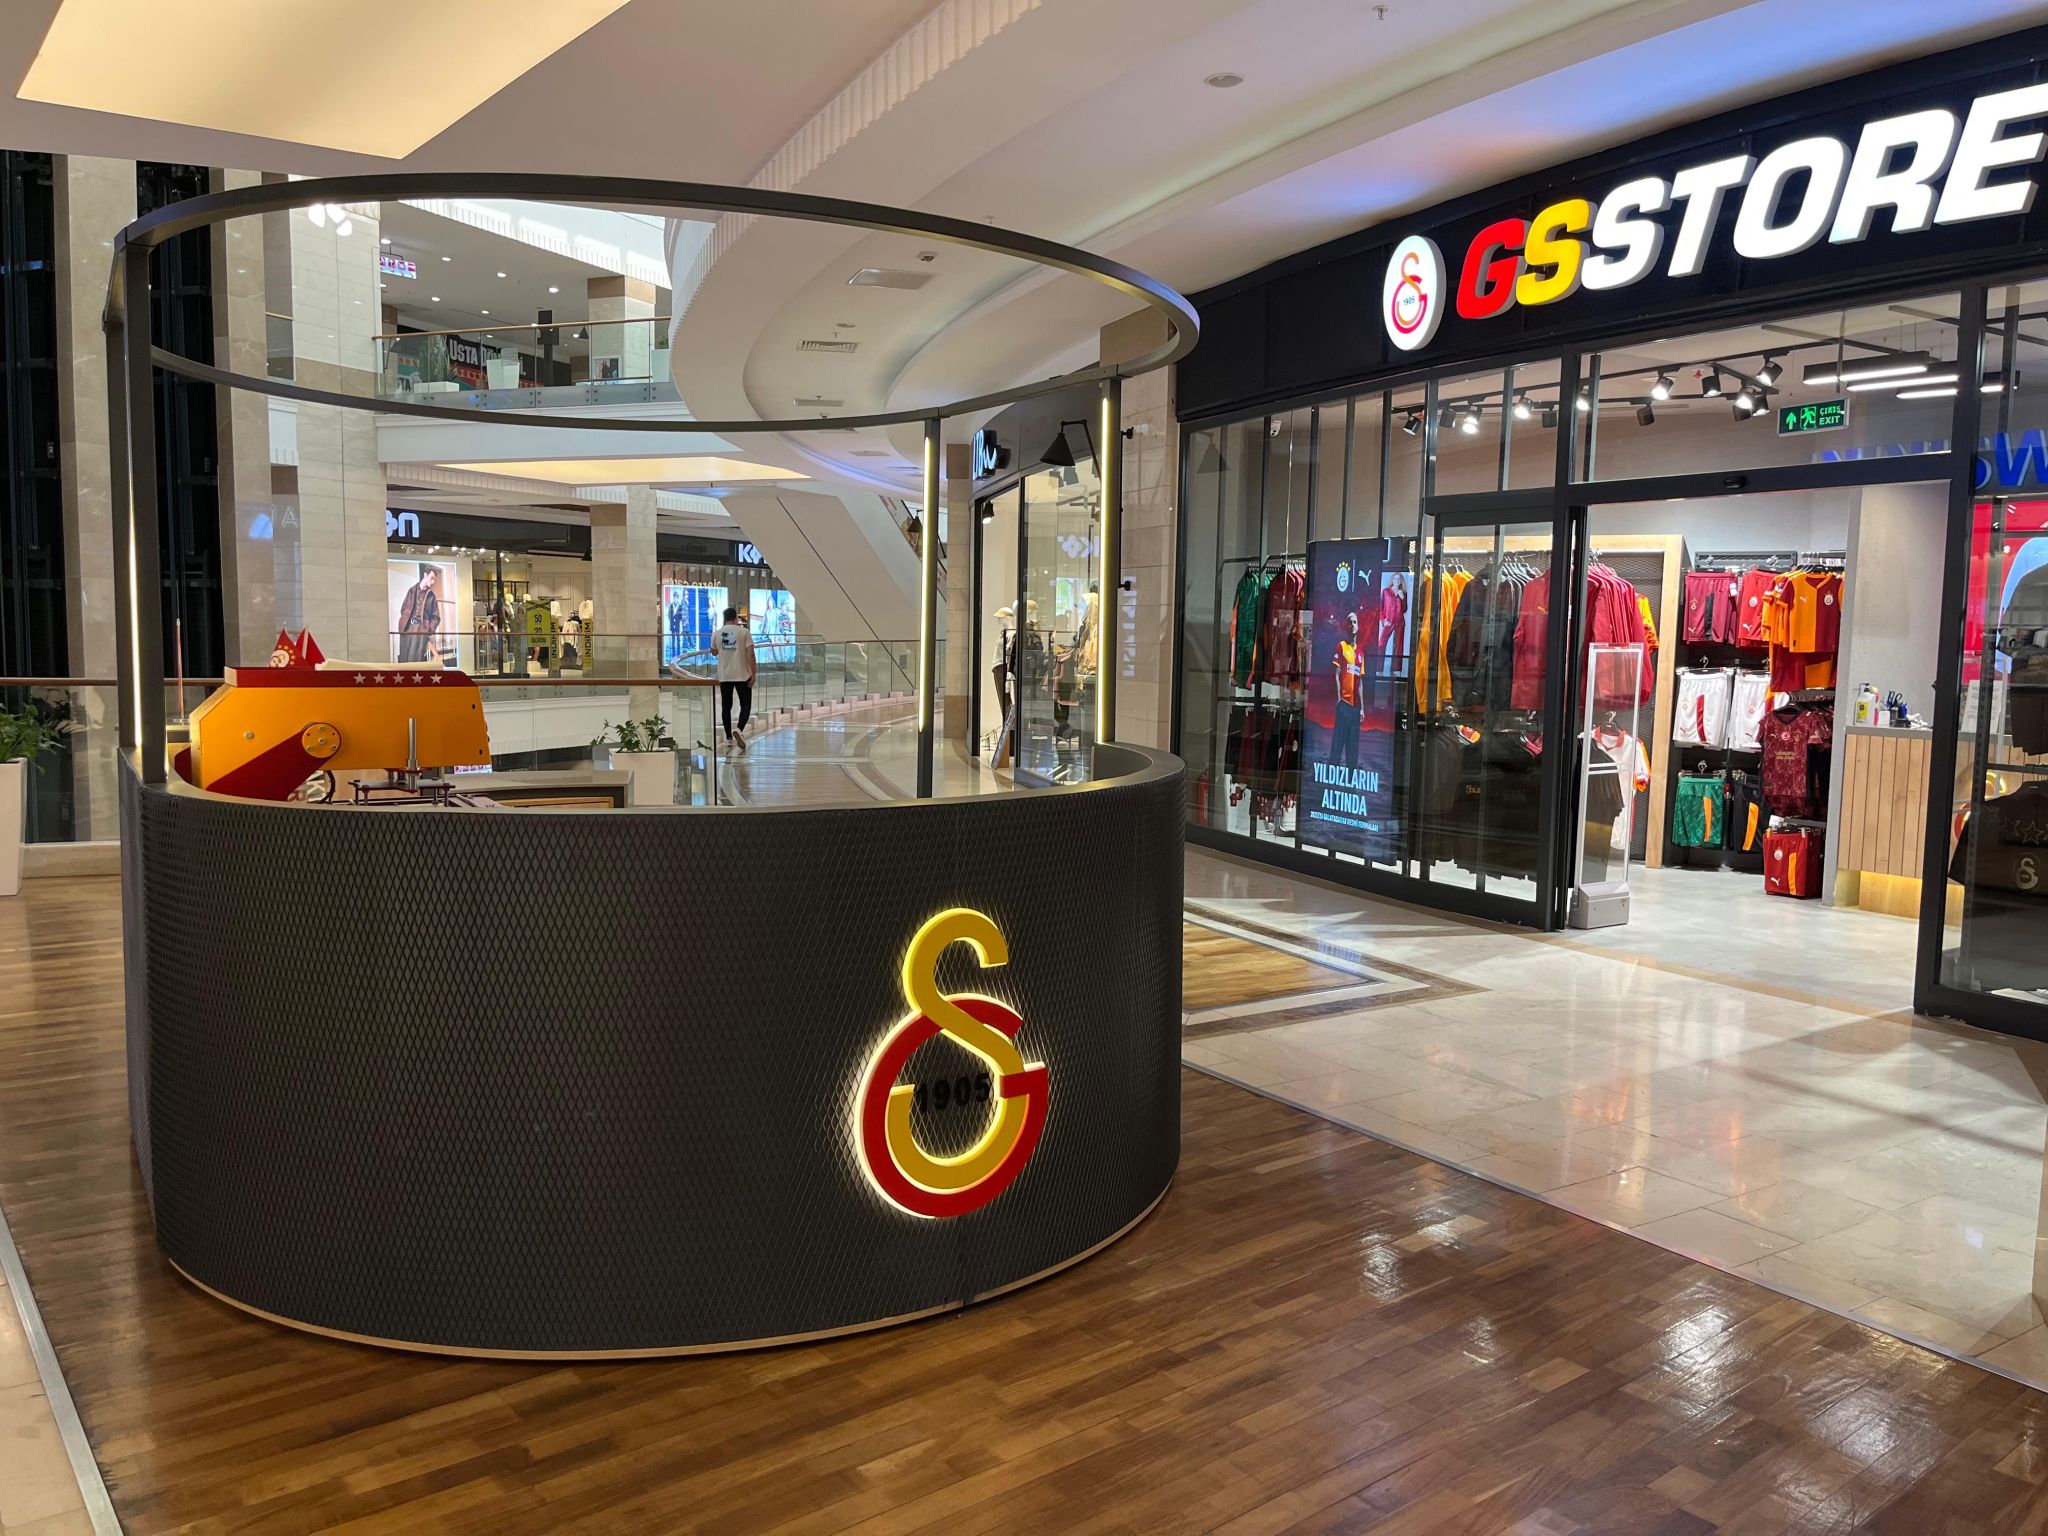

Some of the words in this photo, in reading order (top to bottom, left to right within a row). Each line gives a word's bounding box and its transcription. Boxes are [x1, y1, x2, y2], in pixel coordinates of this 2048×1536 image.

[449, 339, 479, 366] USTA
[1819, 415, 1841, 425] EXIT
[1313, 762, 1379, 793] YILDIZLARIN
[1321, 788, 1367, 817] ALTINDA
[915, 1072, 990, 1114] 1905
